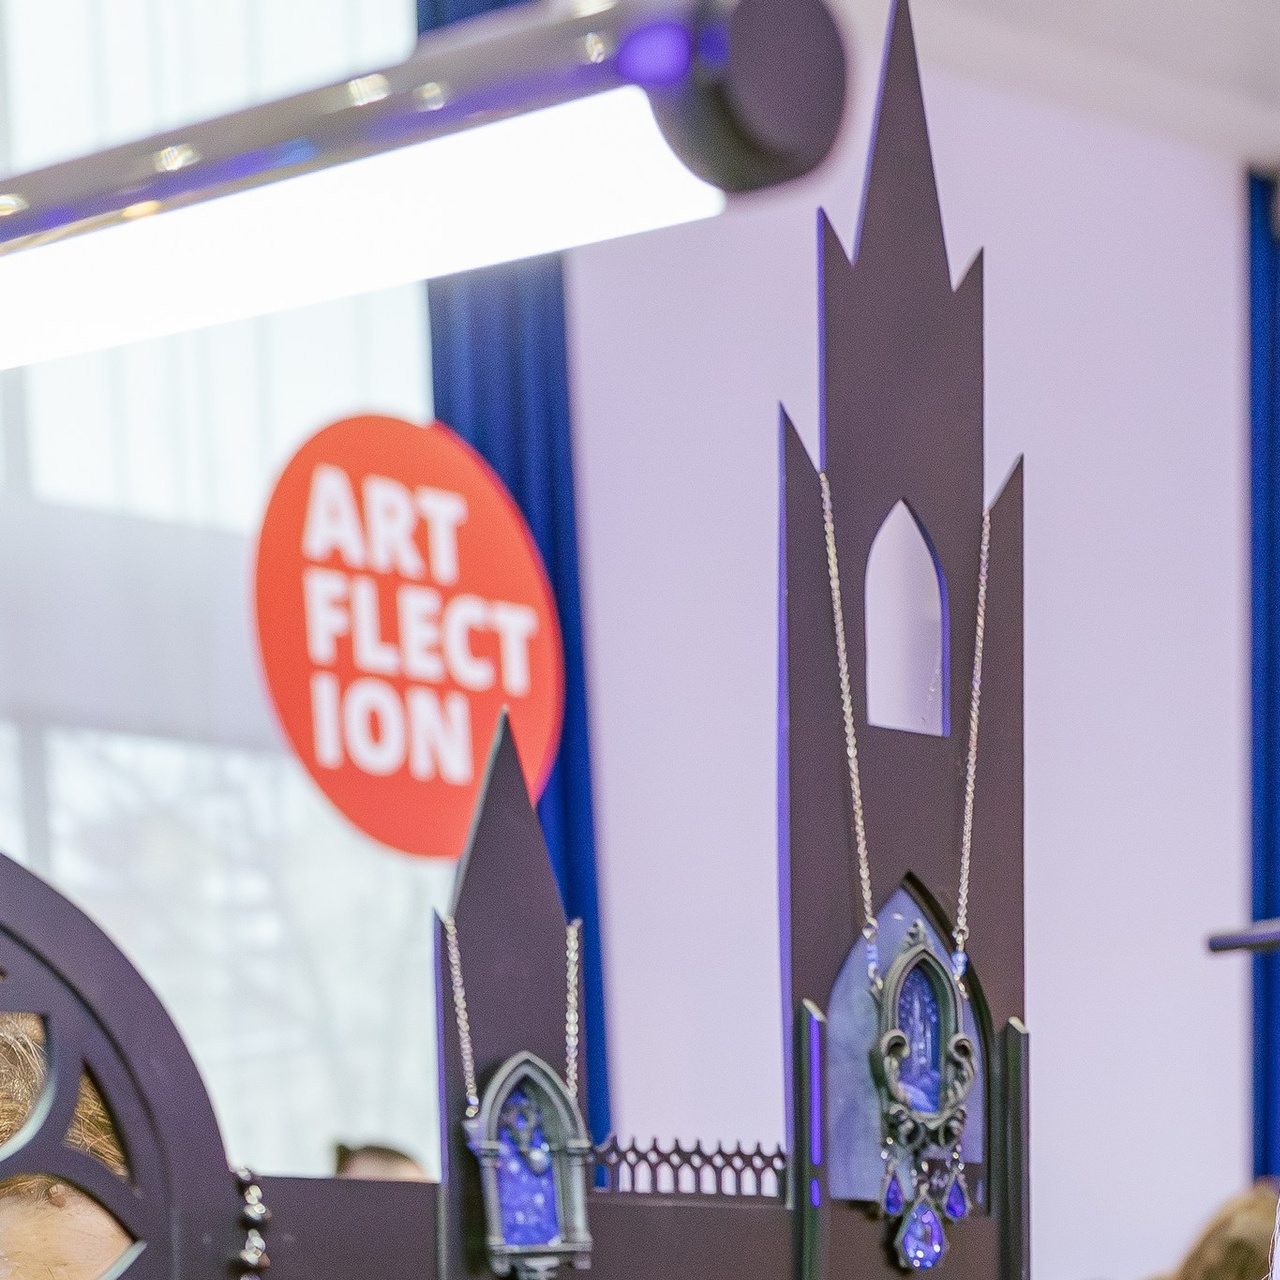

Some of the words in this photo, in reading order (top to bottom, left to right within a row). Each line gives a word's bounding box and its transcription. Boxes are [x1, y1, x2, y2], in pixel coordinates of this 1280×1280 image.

[302, 463, 469, 586] ART
[303, 567, 539, 697] FLECT
[309, 671, 474, 786] ION
